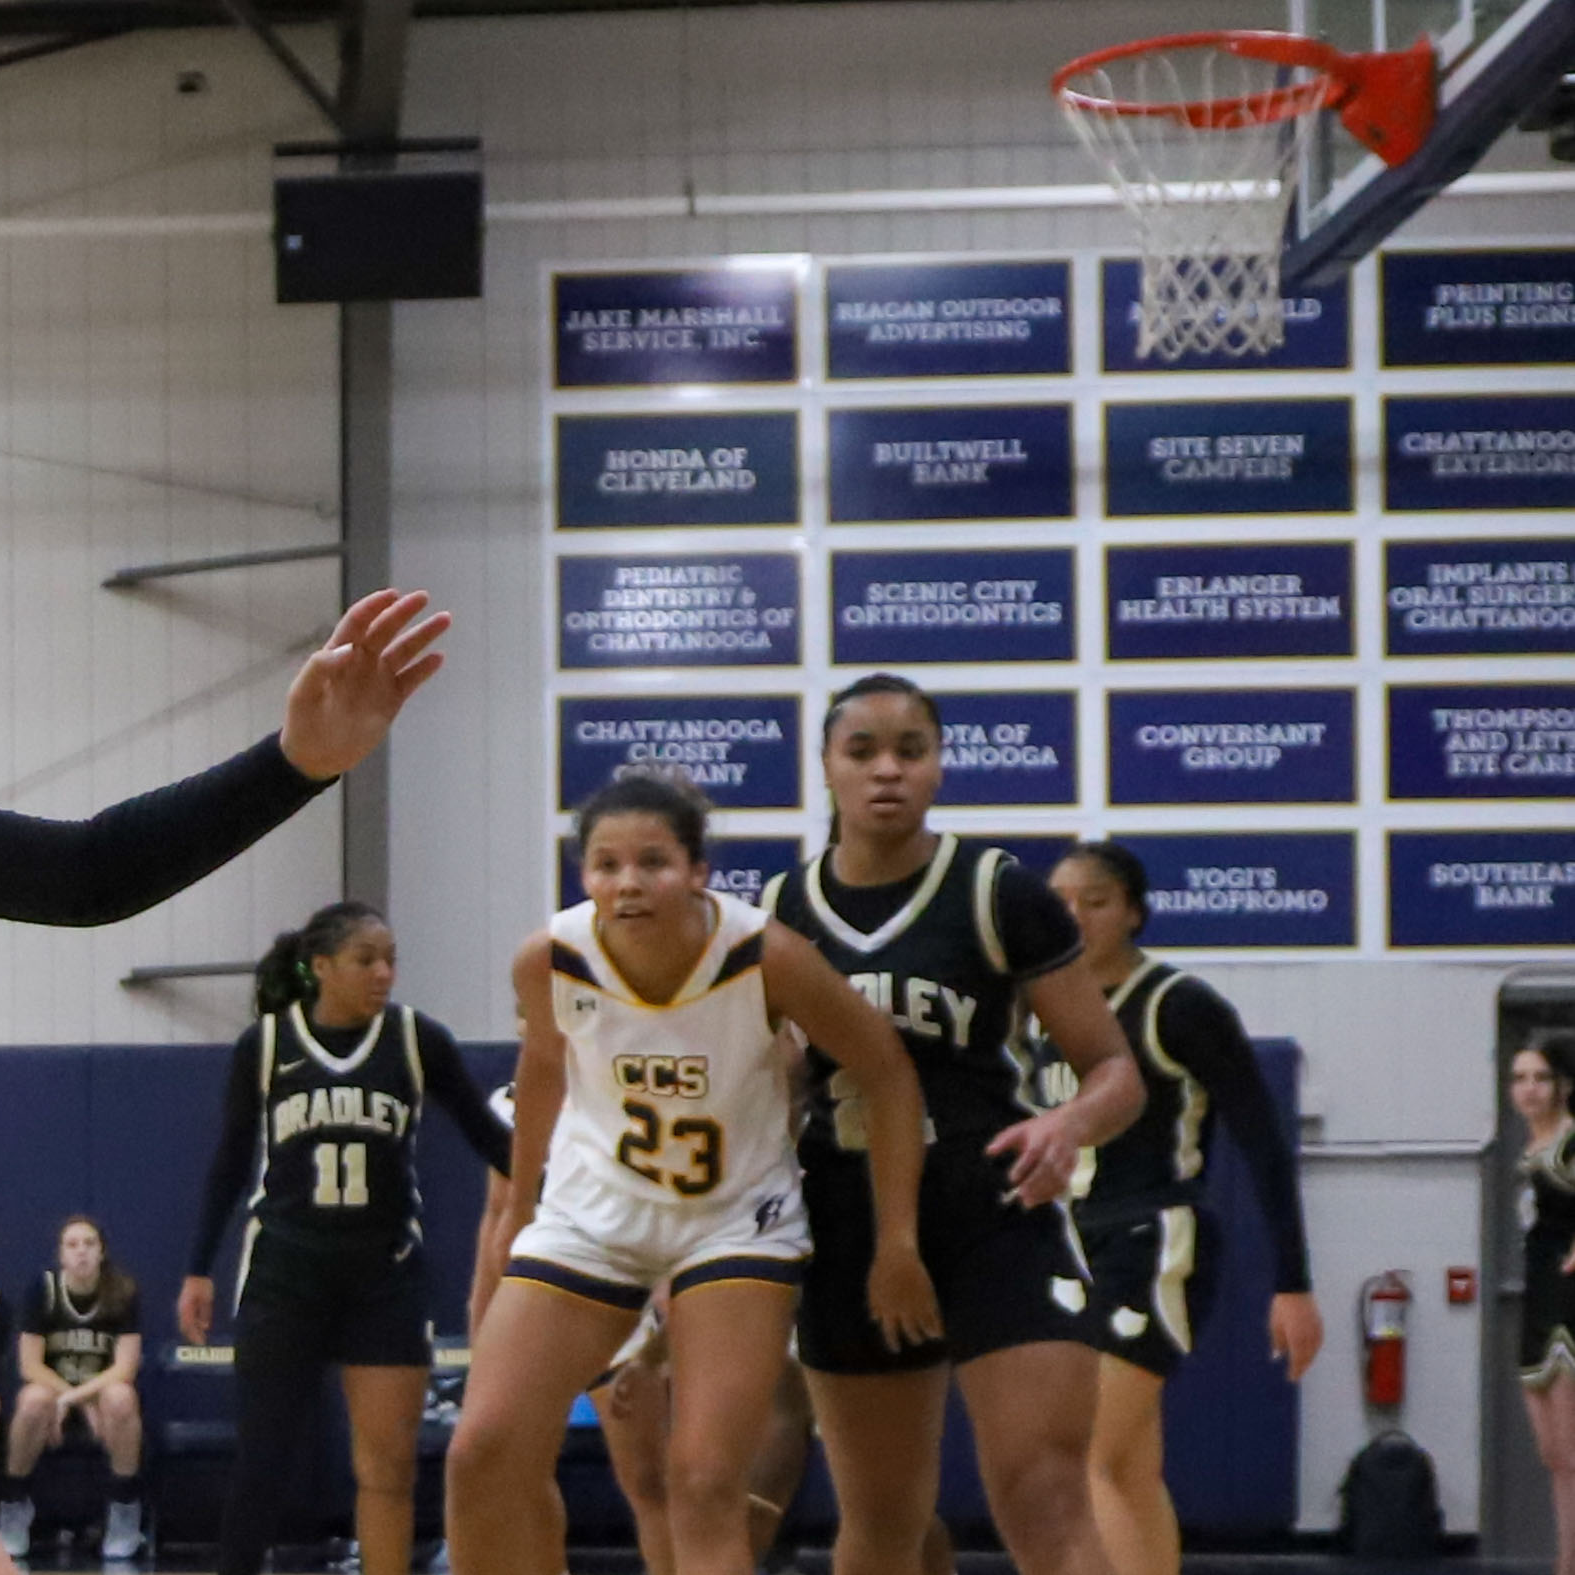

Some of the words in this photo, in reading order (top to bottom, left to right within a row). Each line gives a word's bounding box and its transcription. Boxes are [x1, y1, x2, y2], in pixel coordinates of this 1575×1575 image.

[1435, 283, 1575, 303] PRINTING
[564, 309, 632, 330] JAKE
[639, 306, 783, 327] MARSHALL
[837, 300, 934, 320] REAGAN
[942, 298, 1063, 319] OUTDOOR
[1427, 305, 1497, 327] PLUS
[582, 330, 701, 351] SERVICE,
[709, 327, 764, 349] INC.
[868, 320, 1030, 341] ADVERTISING
[873, 439, 1026, 461] BUILTWELL
[1150, 436, 1212, 458] SITE
[1218, 434, 1304, 456] SEVEN
[1401, 431, 1575, 454] CHATTANOO
[606, 449, 704, 470] HONDA
[713, 447, 748, 468] OF
[1163, 457, 1293, 479] CAMPERS
[1433, 453, 1575, 474] EXTERIOR
[597, 469, 756, 491] CLEVELAND
[913, 461, 988, 483] BANK
[615, 565, 743, 585] PEDIATRIC
[1428, 563, 1568, 585] IMPLANTS
[602, 587, 736, 606] DENTISTRY
[740, 588, 757, 605] &
[866, 582, 968, 602] SCENIC
[975, 580, 1038, 600] CITY
[1157, 575, 1302, 597] ERLANGER
[1389, 586, 1464, 606] ORAL
[1468, 584, 1575, 604] SURGER
[565, 609, 758, 630] ORTHODONTICS
[762, 608, 795, 627] OF
[842, 603, 1063, 625] ORTHODONTICS
[1118, 598, 1229, 621] HEALTH
[1236, 597, 1340, 619] SYSTEM
[1404, 607, 1575, 629] CHATTANOO
[588, 631, 773, 651] CHATTANOOGA
[576, 719, 783, 740] CHATTANOOGA
[1433, 709, 1575, 731] THOMPSO
[993, 723, 1031, 744] OF
[1136, 725, 1326, 746] CONVERSANT
[1446, 731, 1509, 751] AND
[627, 741, 733, 761] CLOSET
[1181, 746, 1282, 769] GROUP
[1447, 753, 1501, 775] EYE
[1187, 867, 1278, 888] YOGI'S
[1430, 863, 1575, 886] SOUTHEAS
[1474, 886, 1554, 908] BANK
[613, 1053, 709, 1098] CCS
[273, 1087, 410, 1144] BRADLEY
[617, 1098, 723, 1197] 23
[313, 1143, 369, 1206] 11
